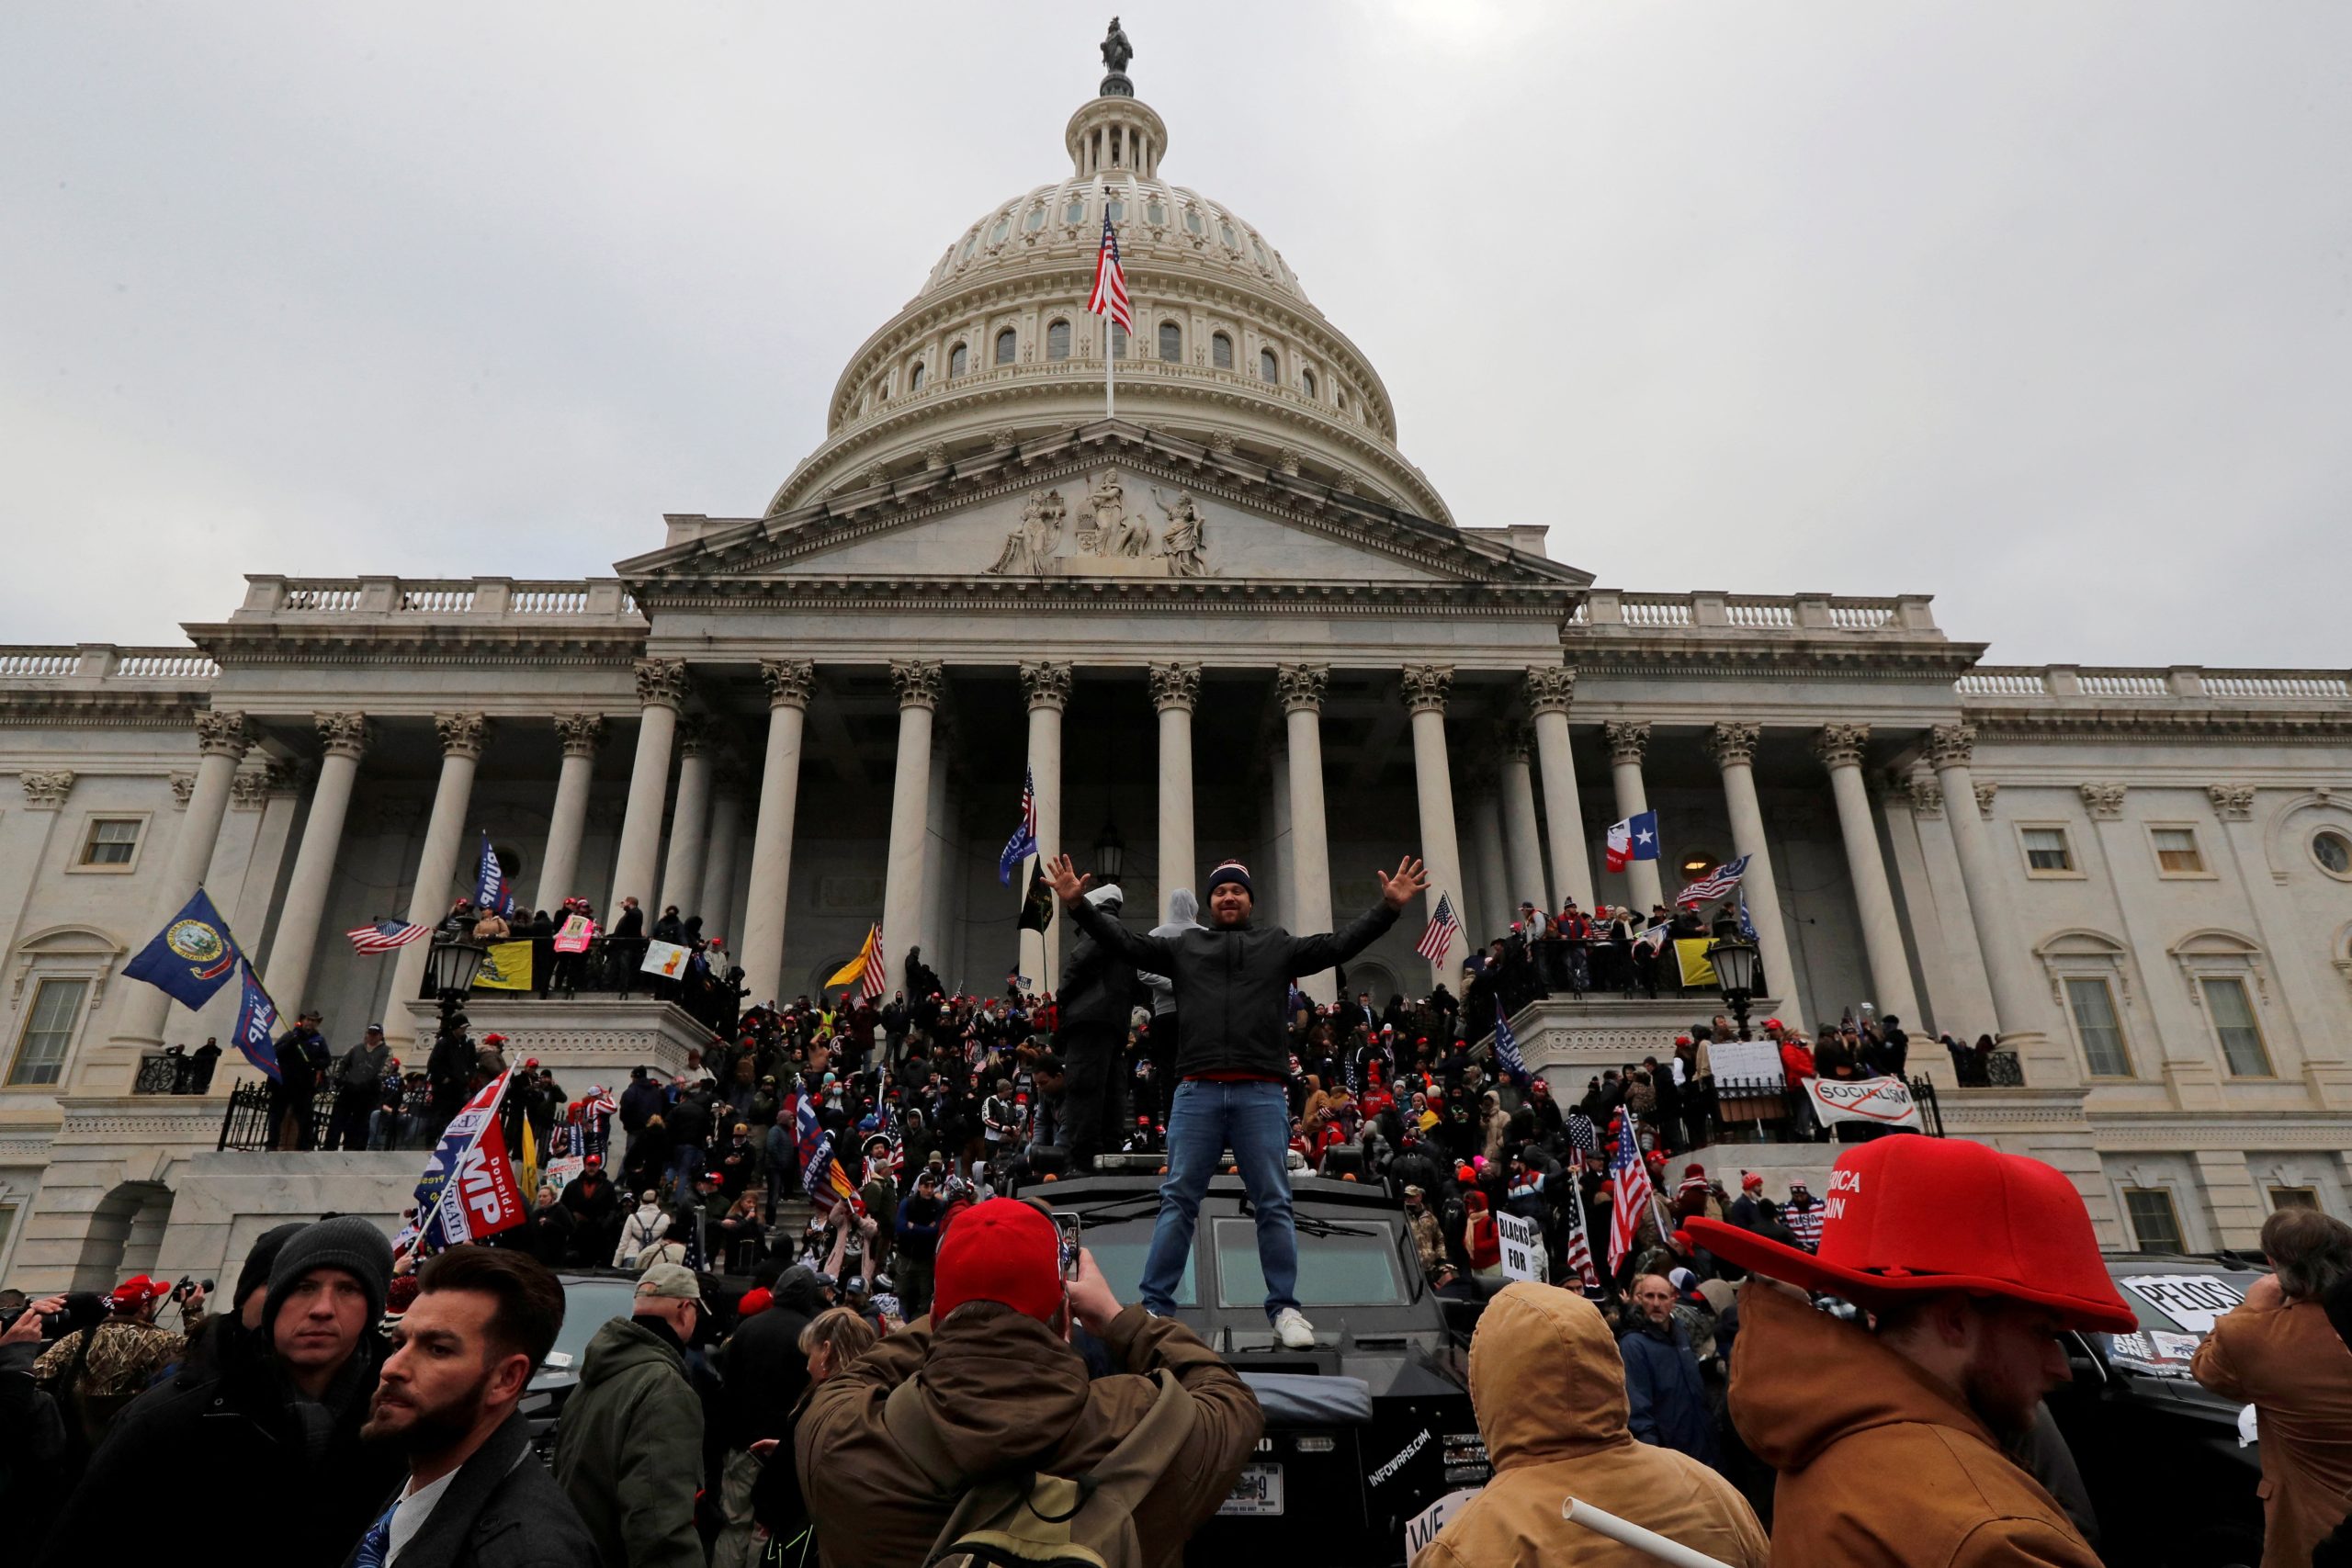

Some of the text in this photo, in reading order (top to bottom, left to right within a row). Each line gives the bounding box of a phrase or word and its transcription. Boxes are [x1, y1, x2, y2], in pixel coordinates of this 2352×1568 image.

[442, 1189, 464, 1236] REAT!
[1498, 1217, 1530, 1246] BLACKS
[1508, 1247, 1527, 1272] FOR
[1367, 1427, 1431, 1488] INFOWARS.COM
